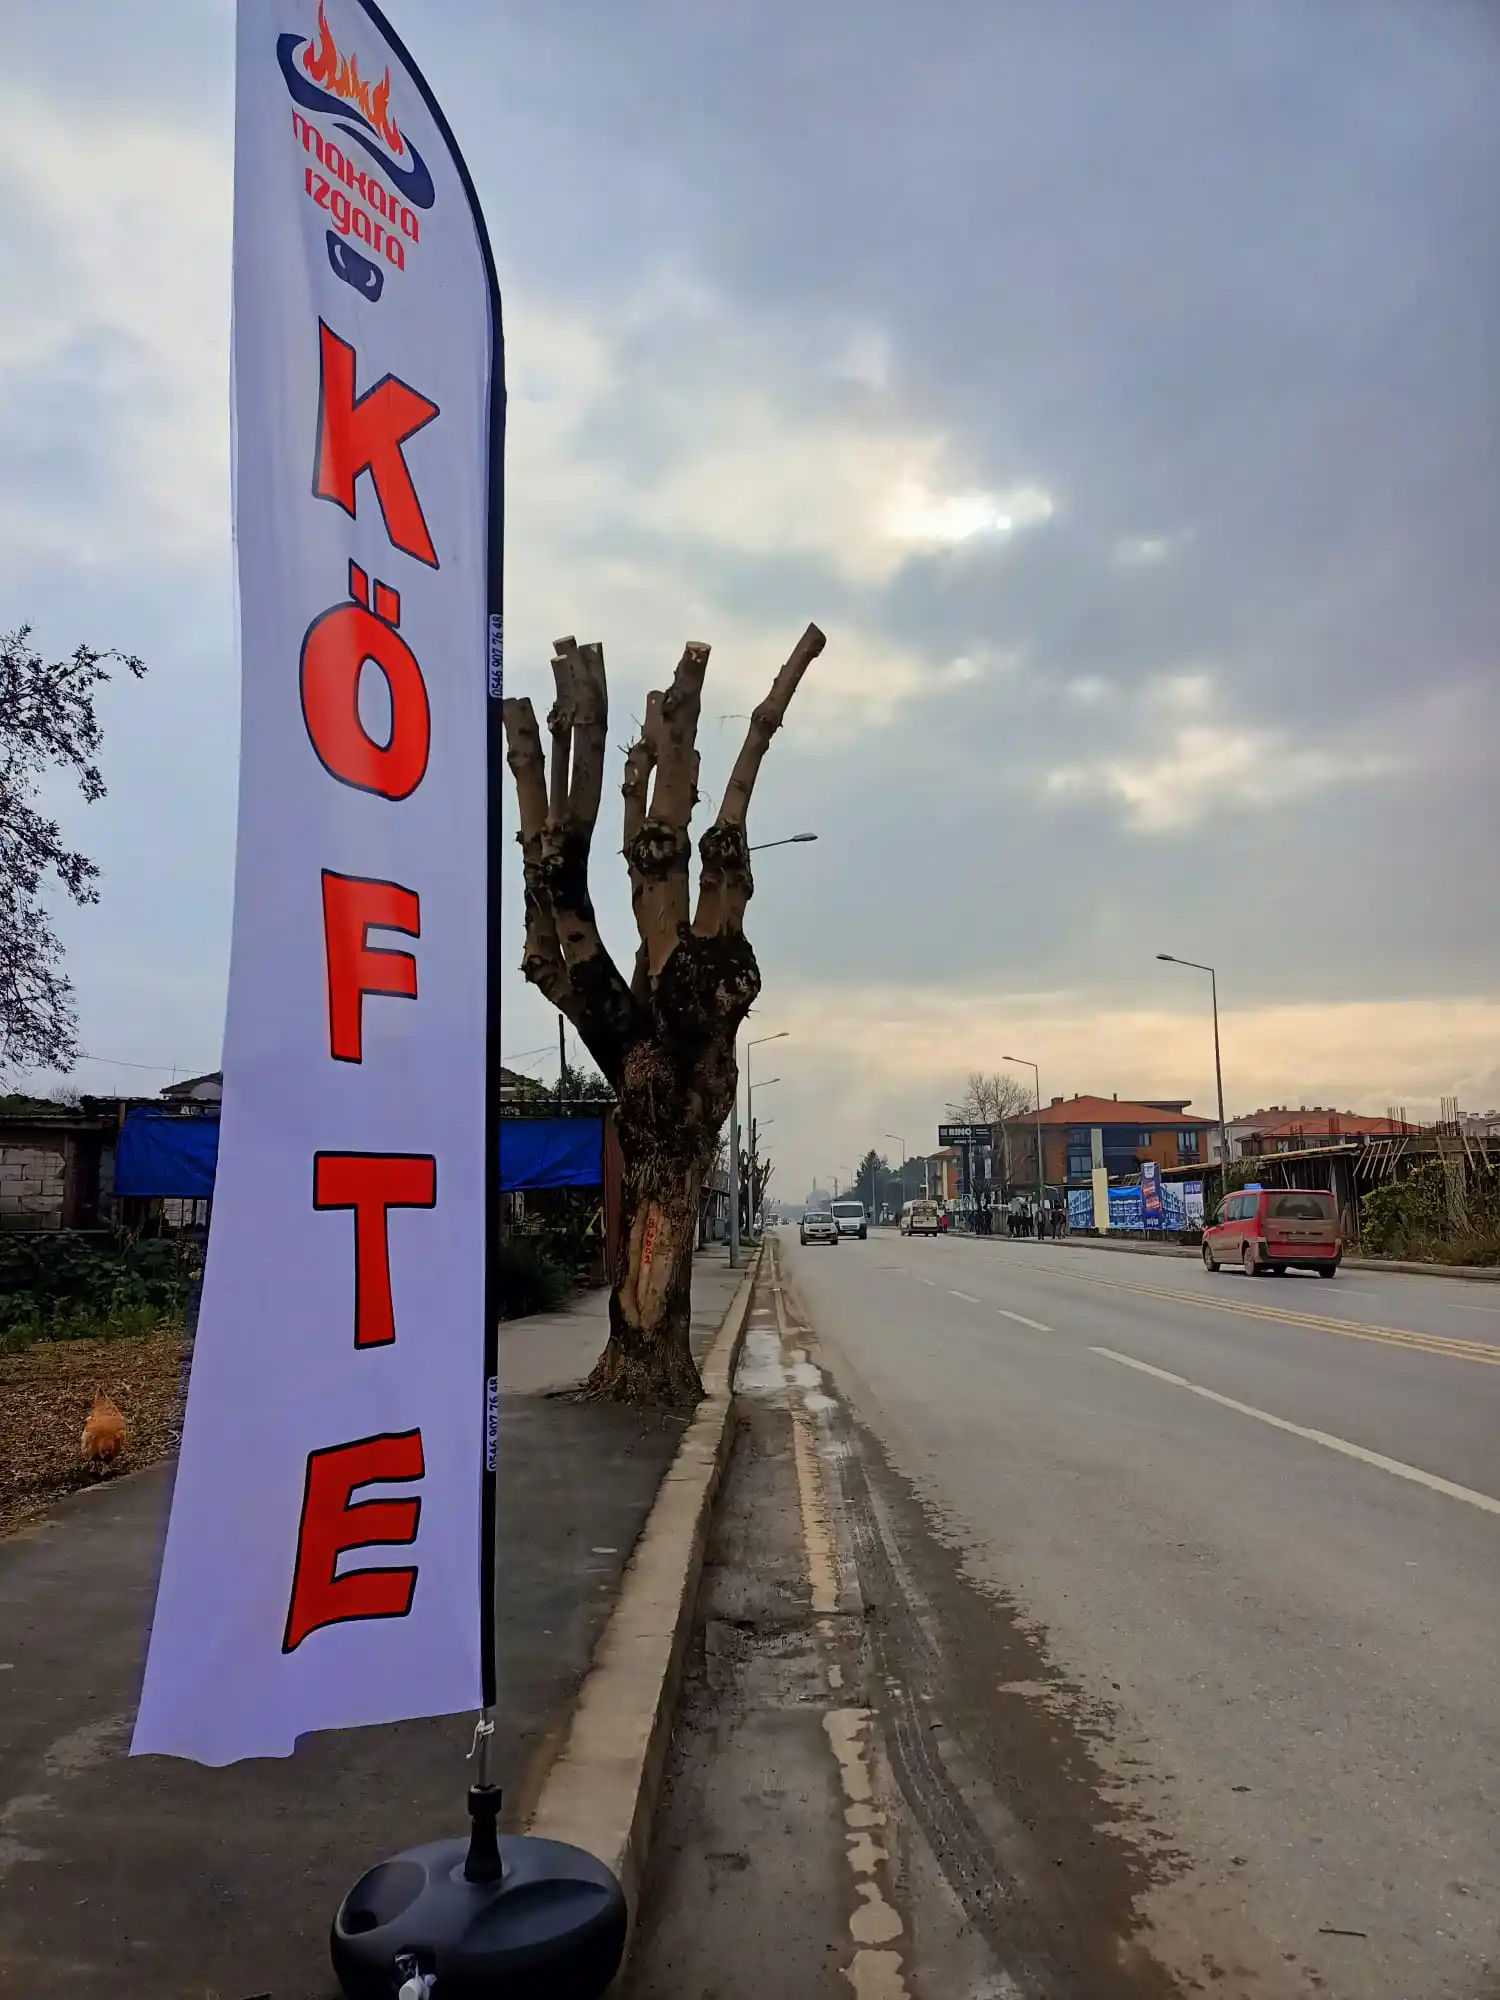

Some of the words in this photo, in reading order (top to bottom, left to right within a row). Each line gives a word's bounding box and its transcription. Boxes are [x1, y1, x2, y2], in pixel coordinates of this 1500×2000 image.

[491, 616, 503, 629] 48
[491, 632, 503, 645] 76
[491, 648, 503, 667] 907
[491, 670, 503, 697] 0546
[282, 316, 440, 1655] KÖFTE
